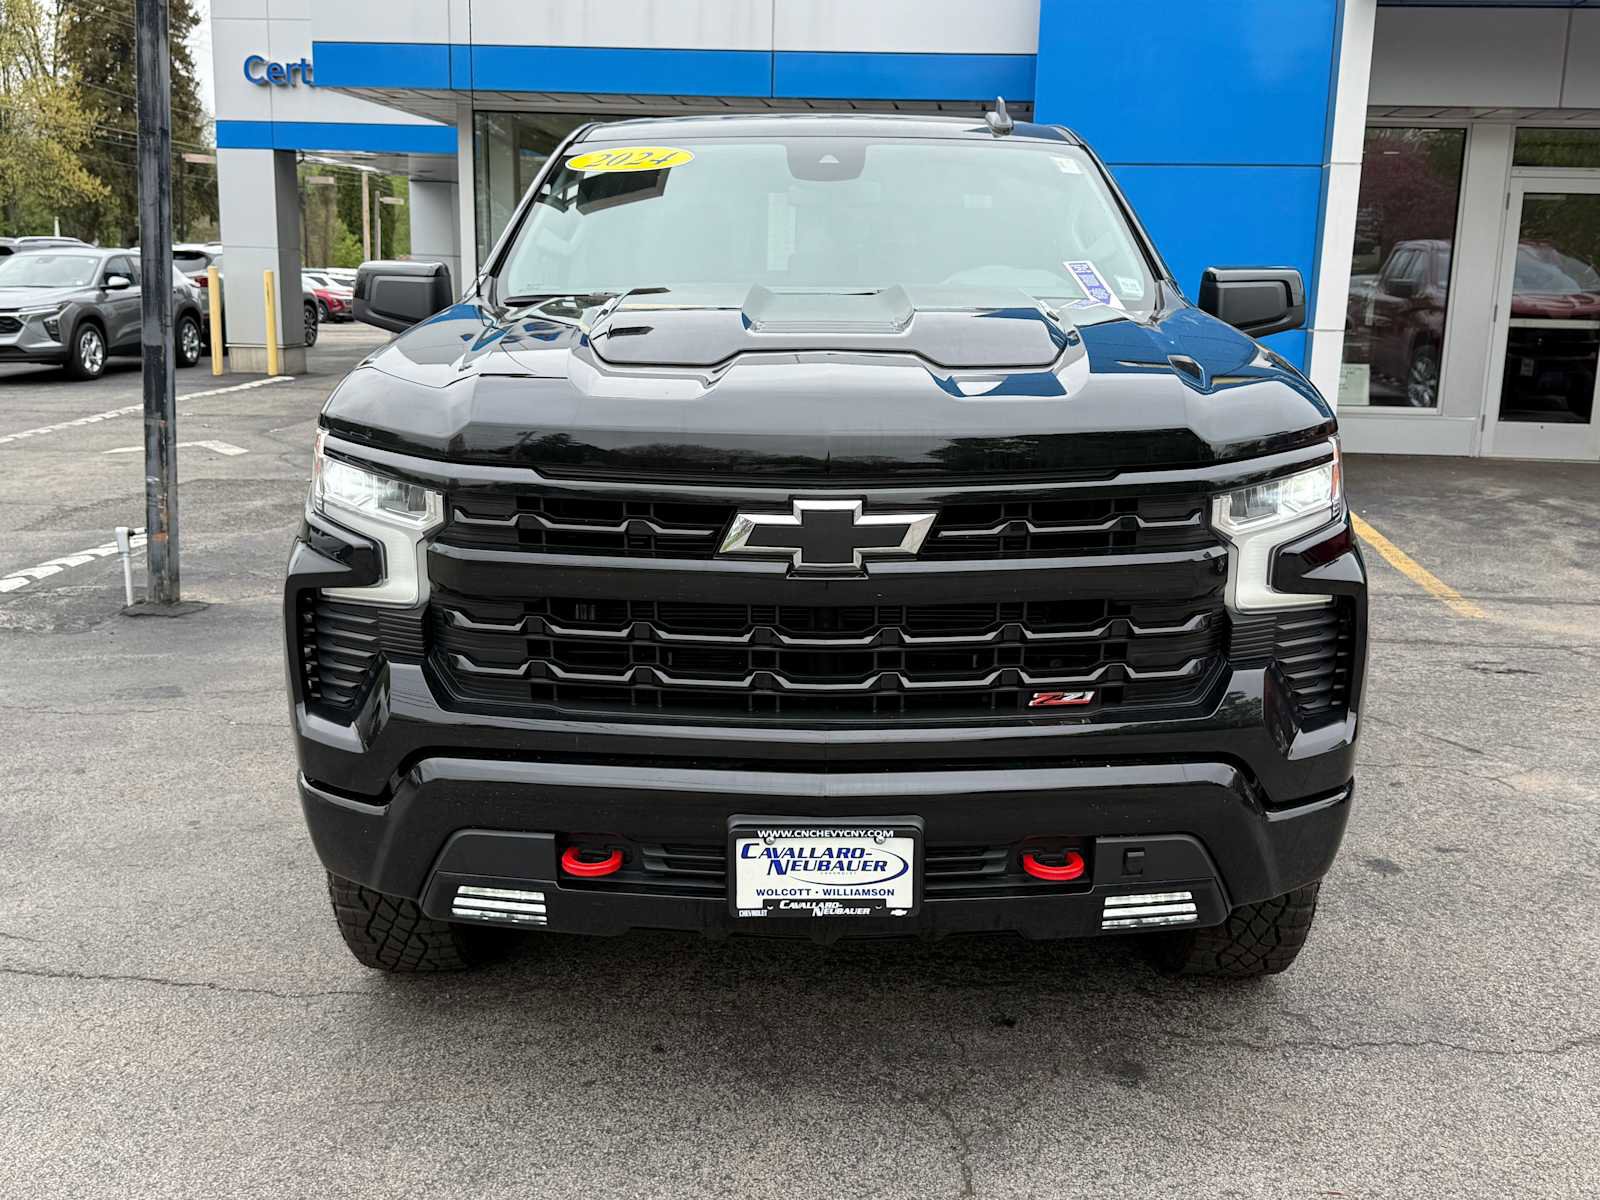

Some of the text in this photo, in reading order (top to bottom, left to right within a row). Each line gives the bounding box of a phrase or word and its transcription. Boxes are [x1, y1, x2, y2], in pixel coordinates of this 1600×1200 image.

[584, 151, 679, 167] 2024
[1028, 691, 1096, 707] Z71
[757, 829, 894, 838] WWW.CNCHEVYCNY.COM
[740, 843, 872, 859] CAVALLARO-
[767, 859, 888, 876] NEUBAUER
[756, 888, 895, 896] WOLCOTT WILLIAMSON
[812, 906, 871, 917] NEUBAUER
